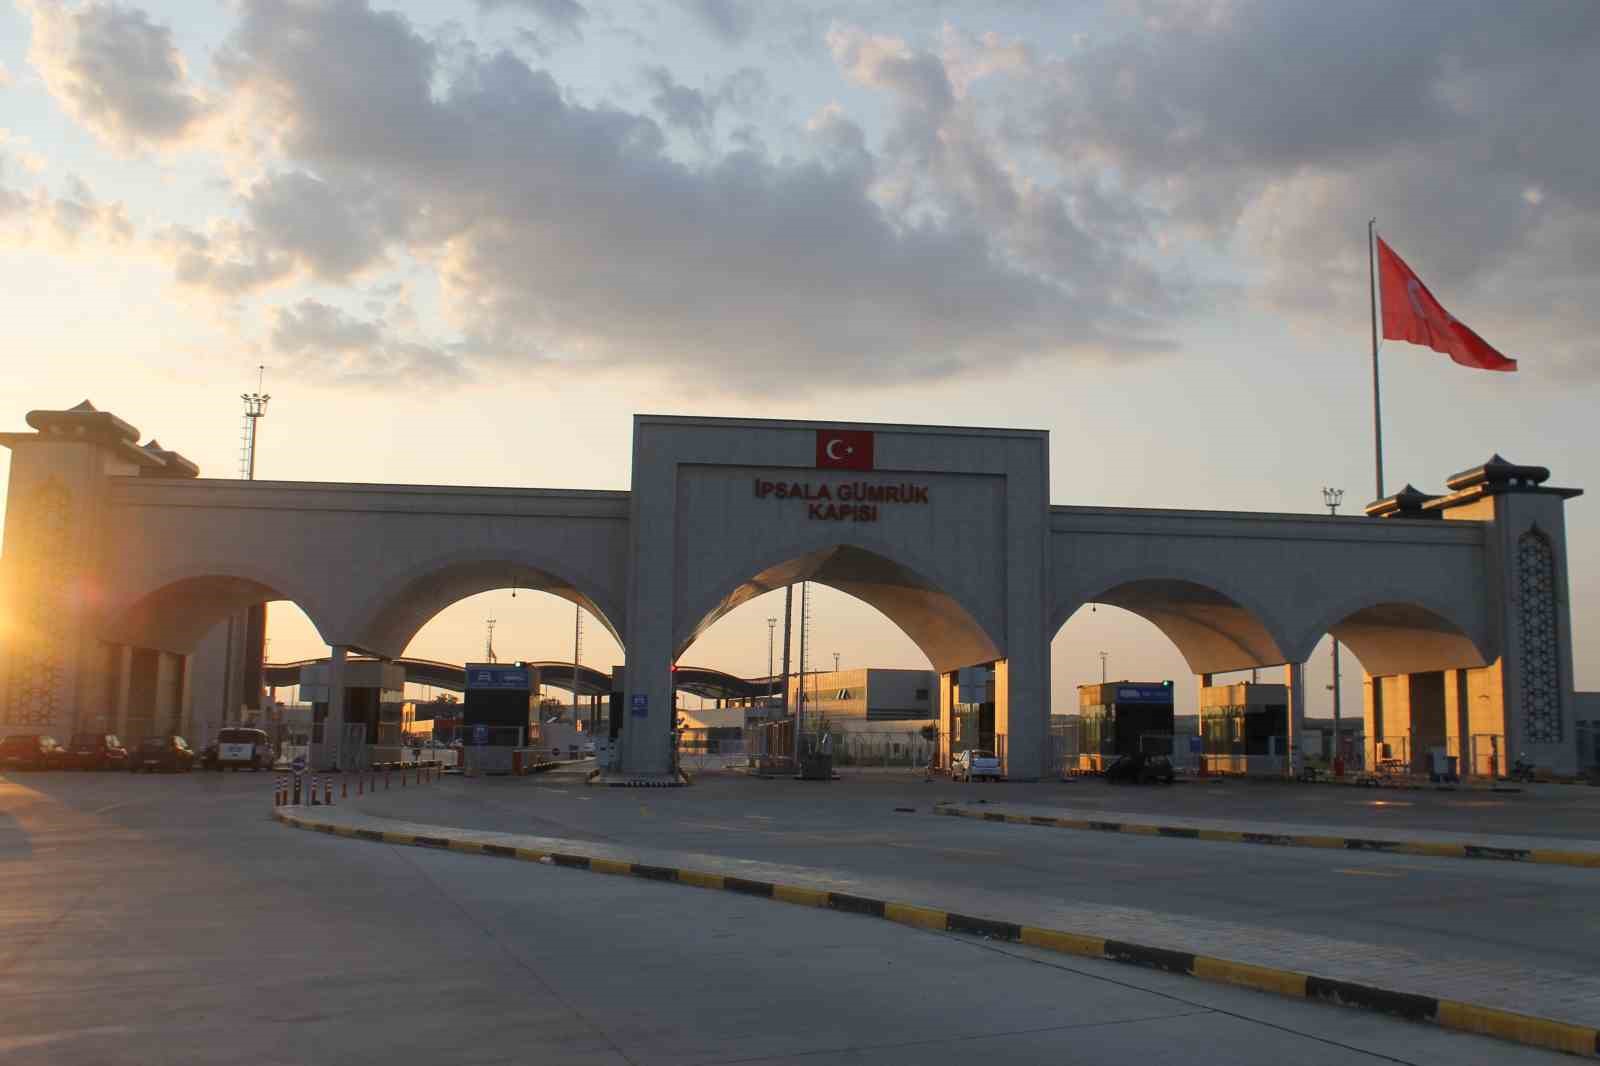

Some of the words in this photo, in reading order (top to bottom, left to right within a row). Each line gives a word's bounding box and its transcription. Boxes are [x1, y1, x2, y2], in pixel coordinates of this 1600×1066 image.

[755, 478, 832, 499] İPSALA
[837, 481, 928, 503] GÜMRÜK
[808, 503, 878, 522] KAPISI
